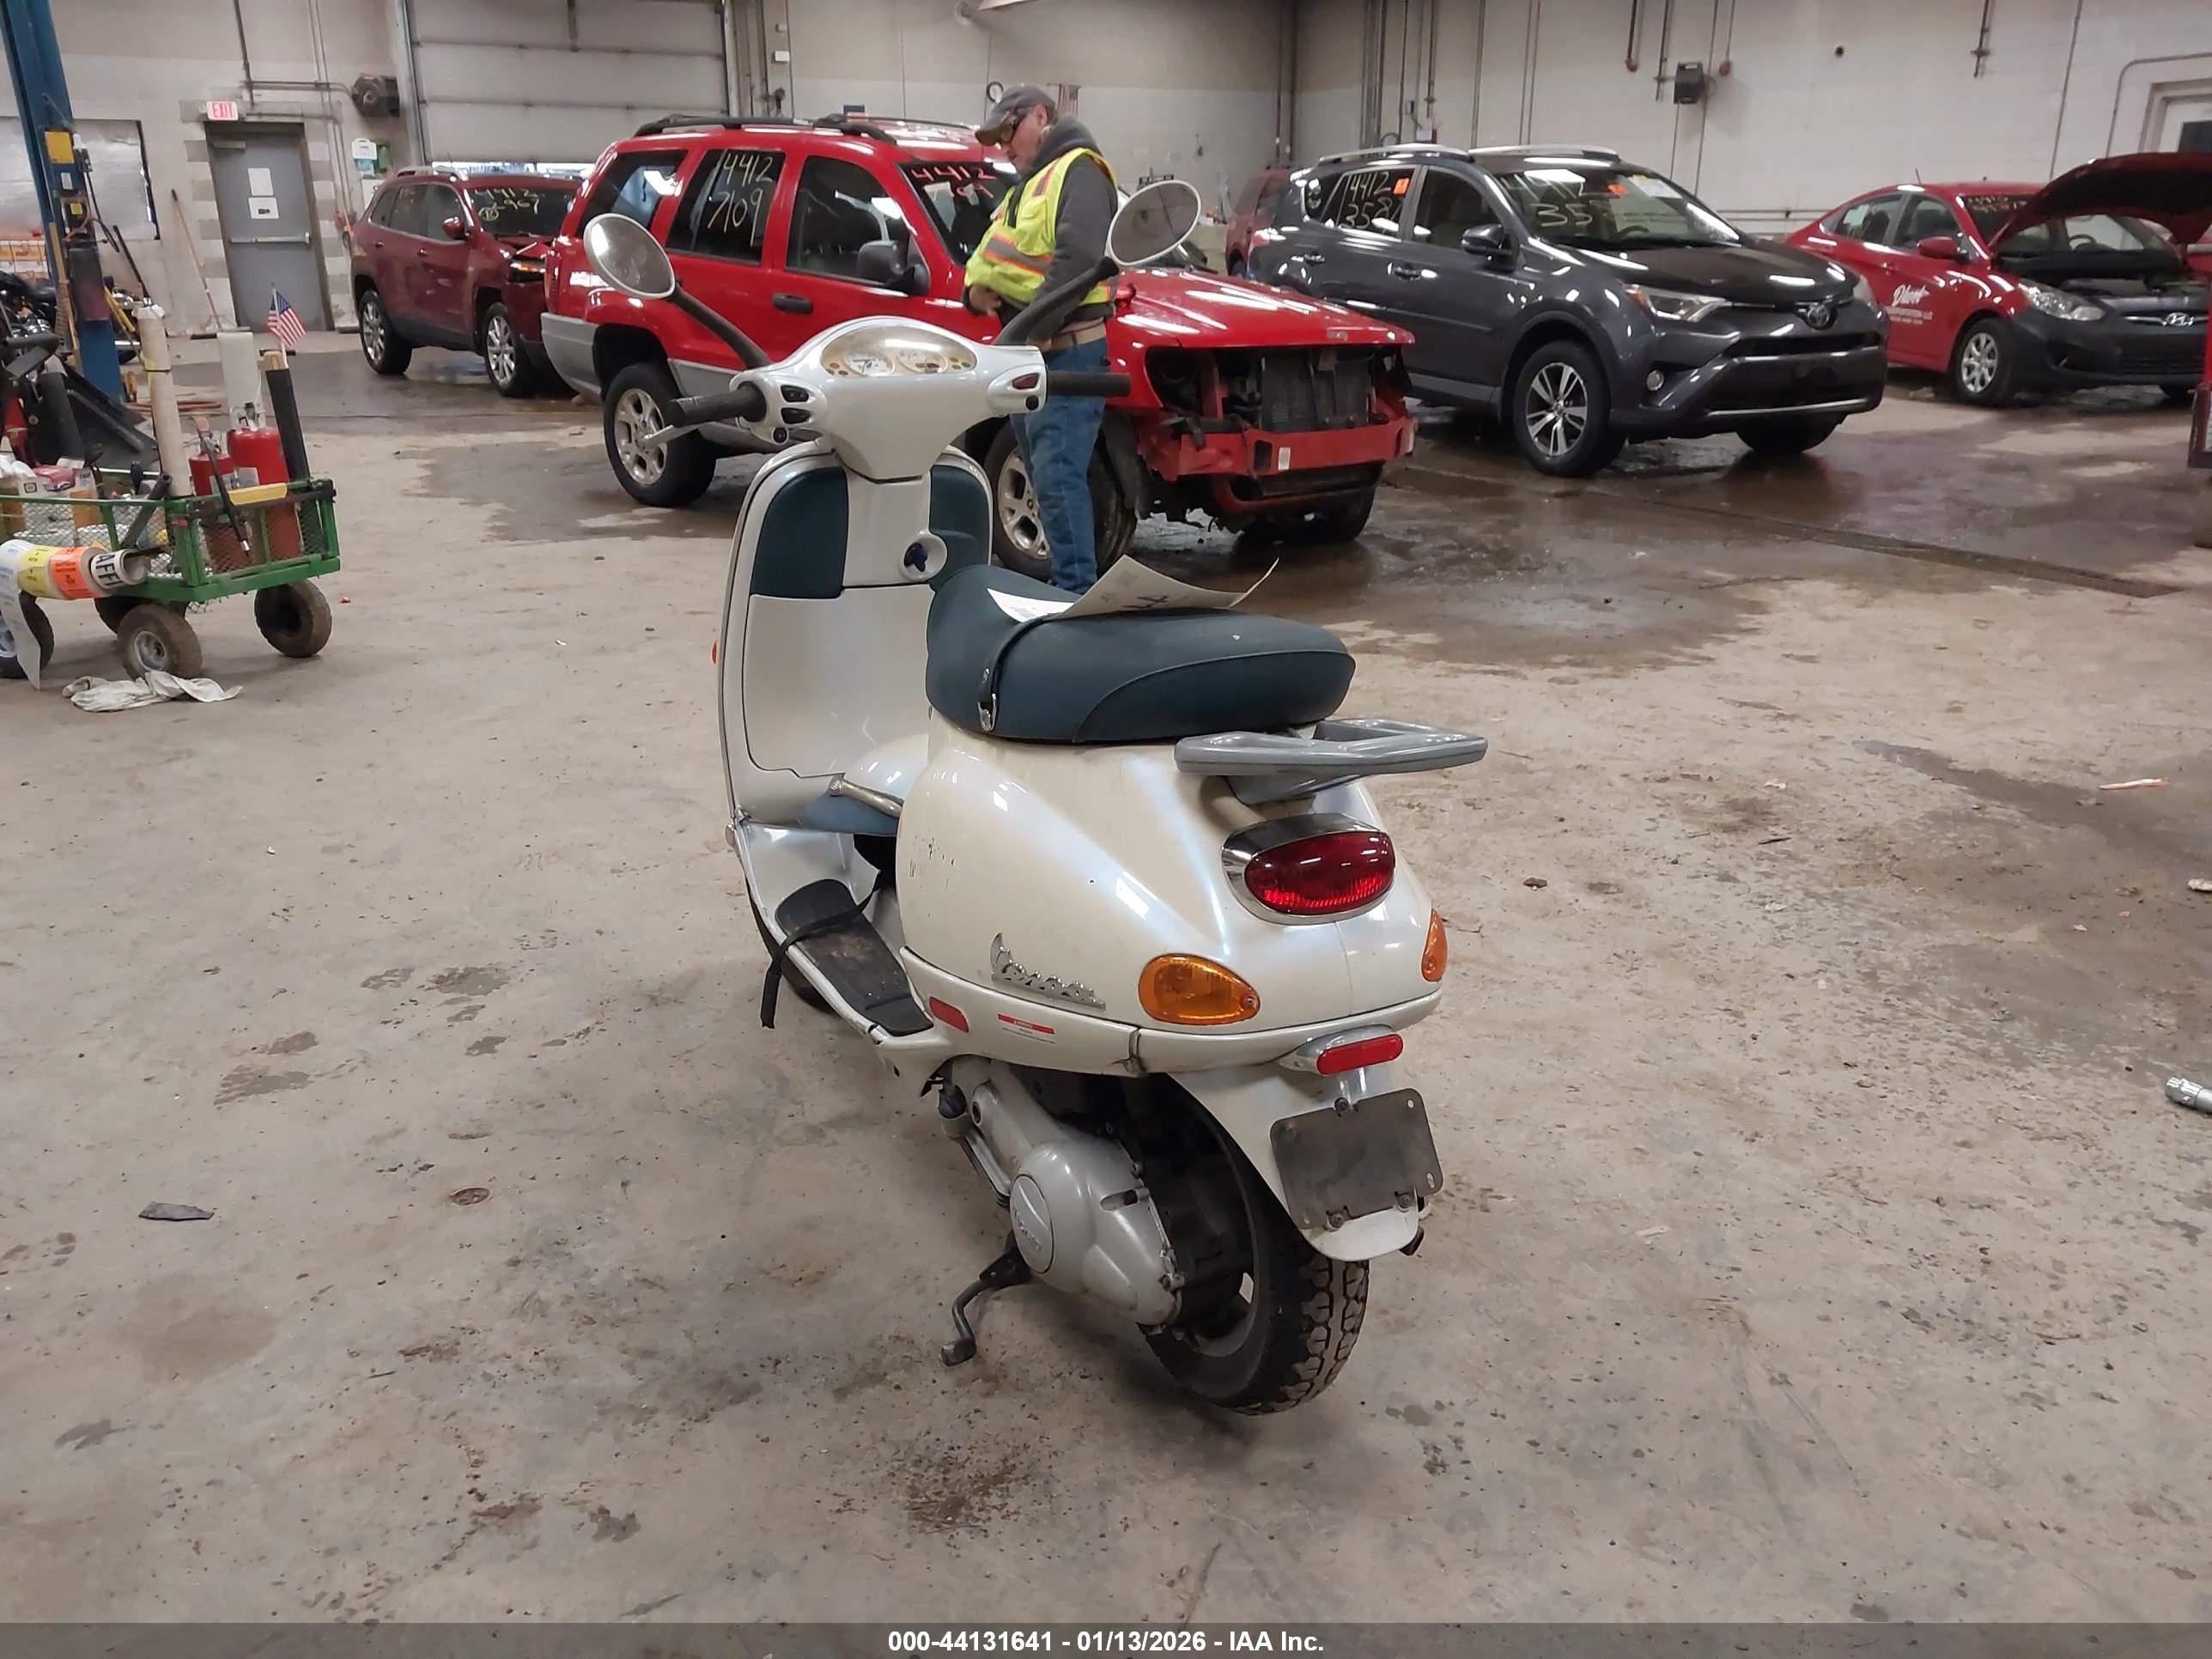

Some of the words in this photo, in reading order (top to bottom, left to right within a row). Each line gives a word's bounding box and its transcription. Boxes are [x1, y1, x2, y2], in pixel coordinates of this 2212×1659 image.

[211, 101, 234, 118] EXIT
[723, 153, 773, 187] 4412
[911, 165, 997, 181] 4412
[1350, 171, 1392, 202] 4412
[707, 187, 763, 247] 7109
